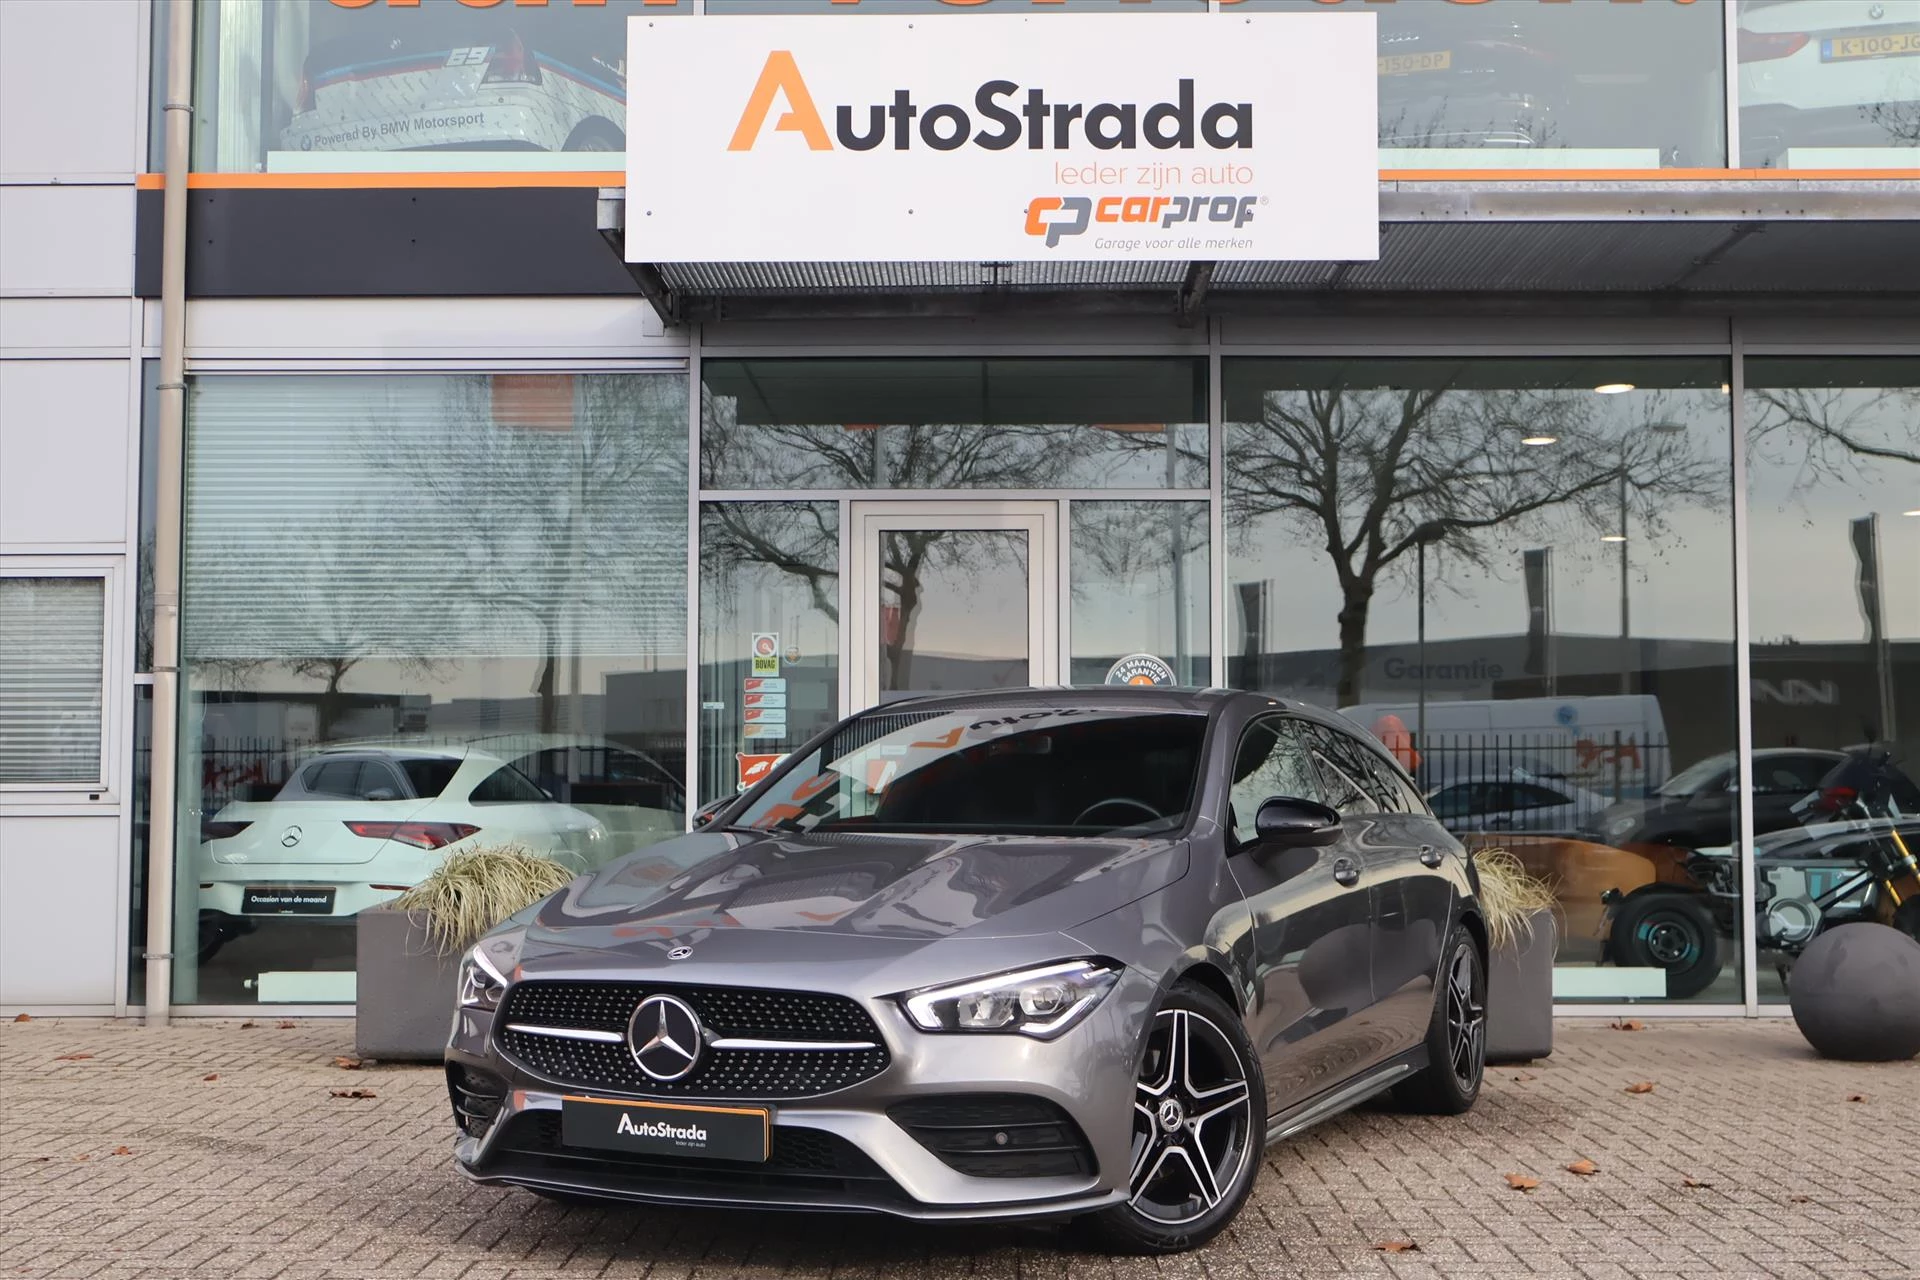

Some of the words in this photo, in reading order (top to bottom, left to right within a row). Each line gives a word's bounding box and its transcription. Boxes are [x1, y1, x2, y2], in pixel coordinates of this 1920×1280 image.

[446, 46, 490, 66] 69
[1378, 53, 1444, 73] -150-DP
[726, 50, 1253, 152] AutoStrada
[314, 128, 359, 147] Powered
[362, 126, 377, 139] By
[380, 120, 411, 136] BMW
[414, 112, 485, 130] Motorsport
[1055, 161, 1127, 185] Ieder
[1137, 162, 1181, 190] zijn
[1191, 165, 1253, 185] auto
[1094, 237, 1141, 252] Garage
[1145, 240, 1175, 249] voor
[1178, 237, 1200, 249] alle
[1205, 237, 1253, 249] merken
[755, 659, 776, 670] BOVAG
[1115, 666, 1126, 678] 24
[1126, 659, 1168, 680] MAANDEN
[1383, 658, 1504, 679] Garantie
[1121, 667, 1161, 684] GARANTIE
[250, 895, 279, 903] Occasion
[293, 895, 302, 903] de
[303, 895, 328, 903] maand
[617, 1112, 707, 1141] AutoStrada
